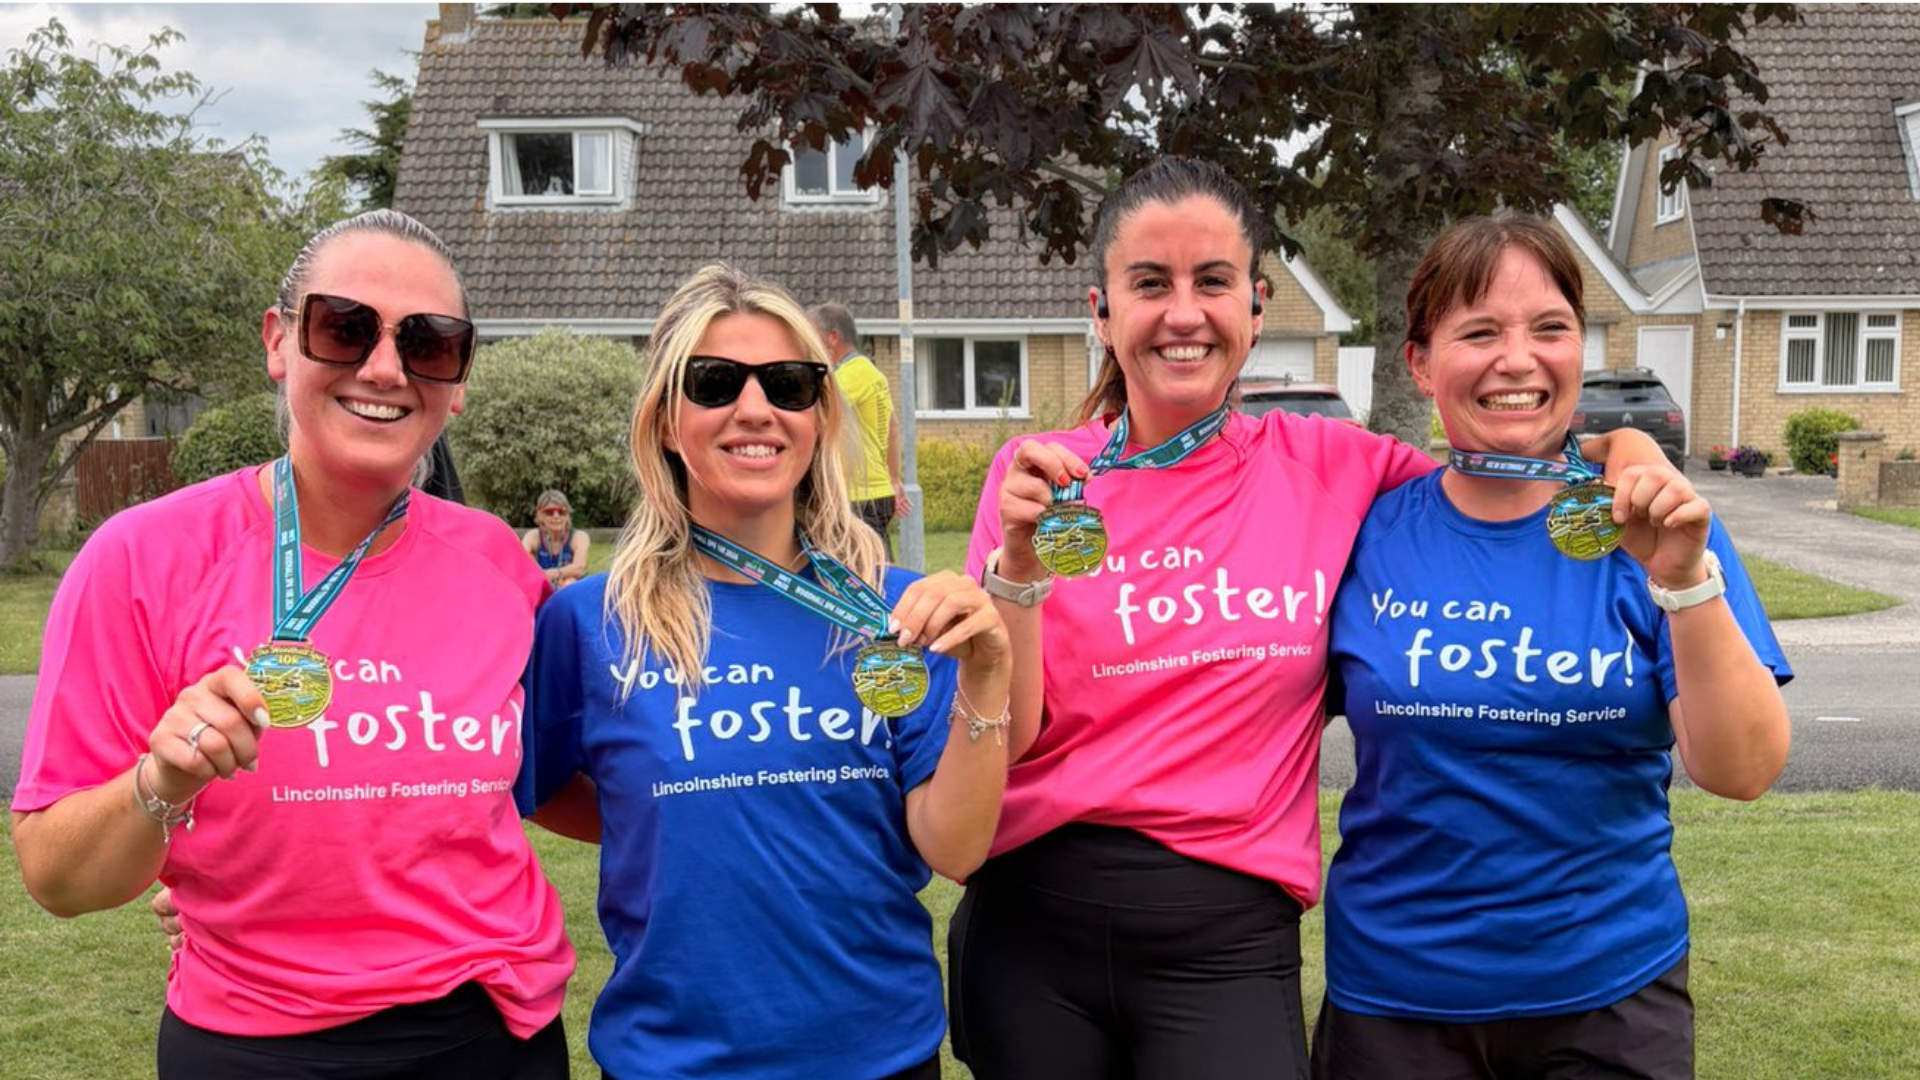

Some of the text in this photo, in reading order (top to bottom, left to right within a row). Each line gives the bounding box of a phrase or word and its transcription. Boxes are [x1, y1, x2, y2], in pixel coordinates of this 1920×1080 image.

[1140, 546, 1205, 570] can
[1114, 568, 1326, 645] foster!
[1372, 588, 1511, 625] You can
[334, 658, 402, 683] can
[1092, 655, 1188, 678] Lincolnshire
[1192, 644, 1266, 665] Fostering
[1405, 627, 1635, 687] foster!
[701, 664, 774, 684] can
[1375, 700, 1626, 726] Lincolnshire Fostering Service
[272, 783, 386, 802] Lincolnshire
[391, 780, 467, 797] Fostering
[652, 773, 754, 798] Lincolnshire
[758, 766, 837, 786] Fostering
